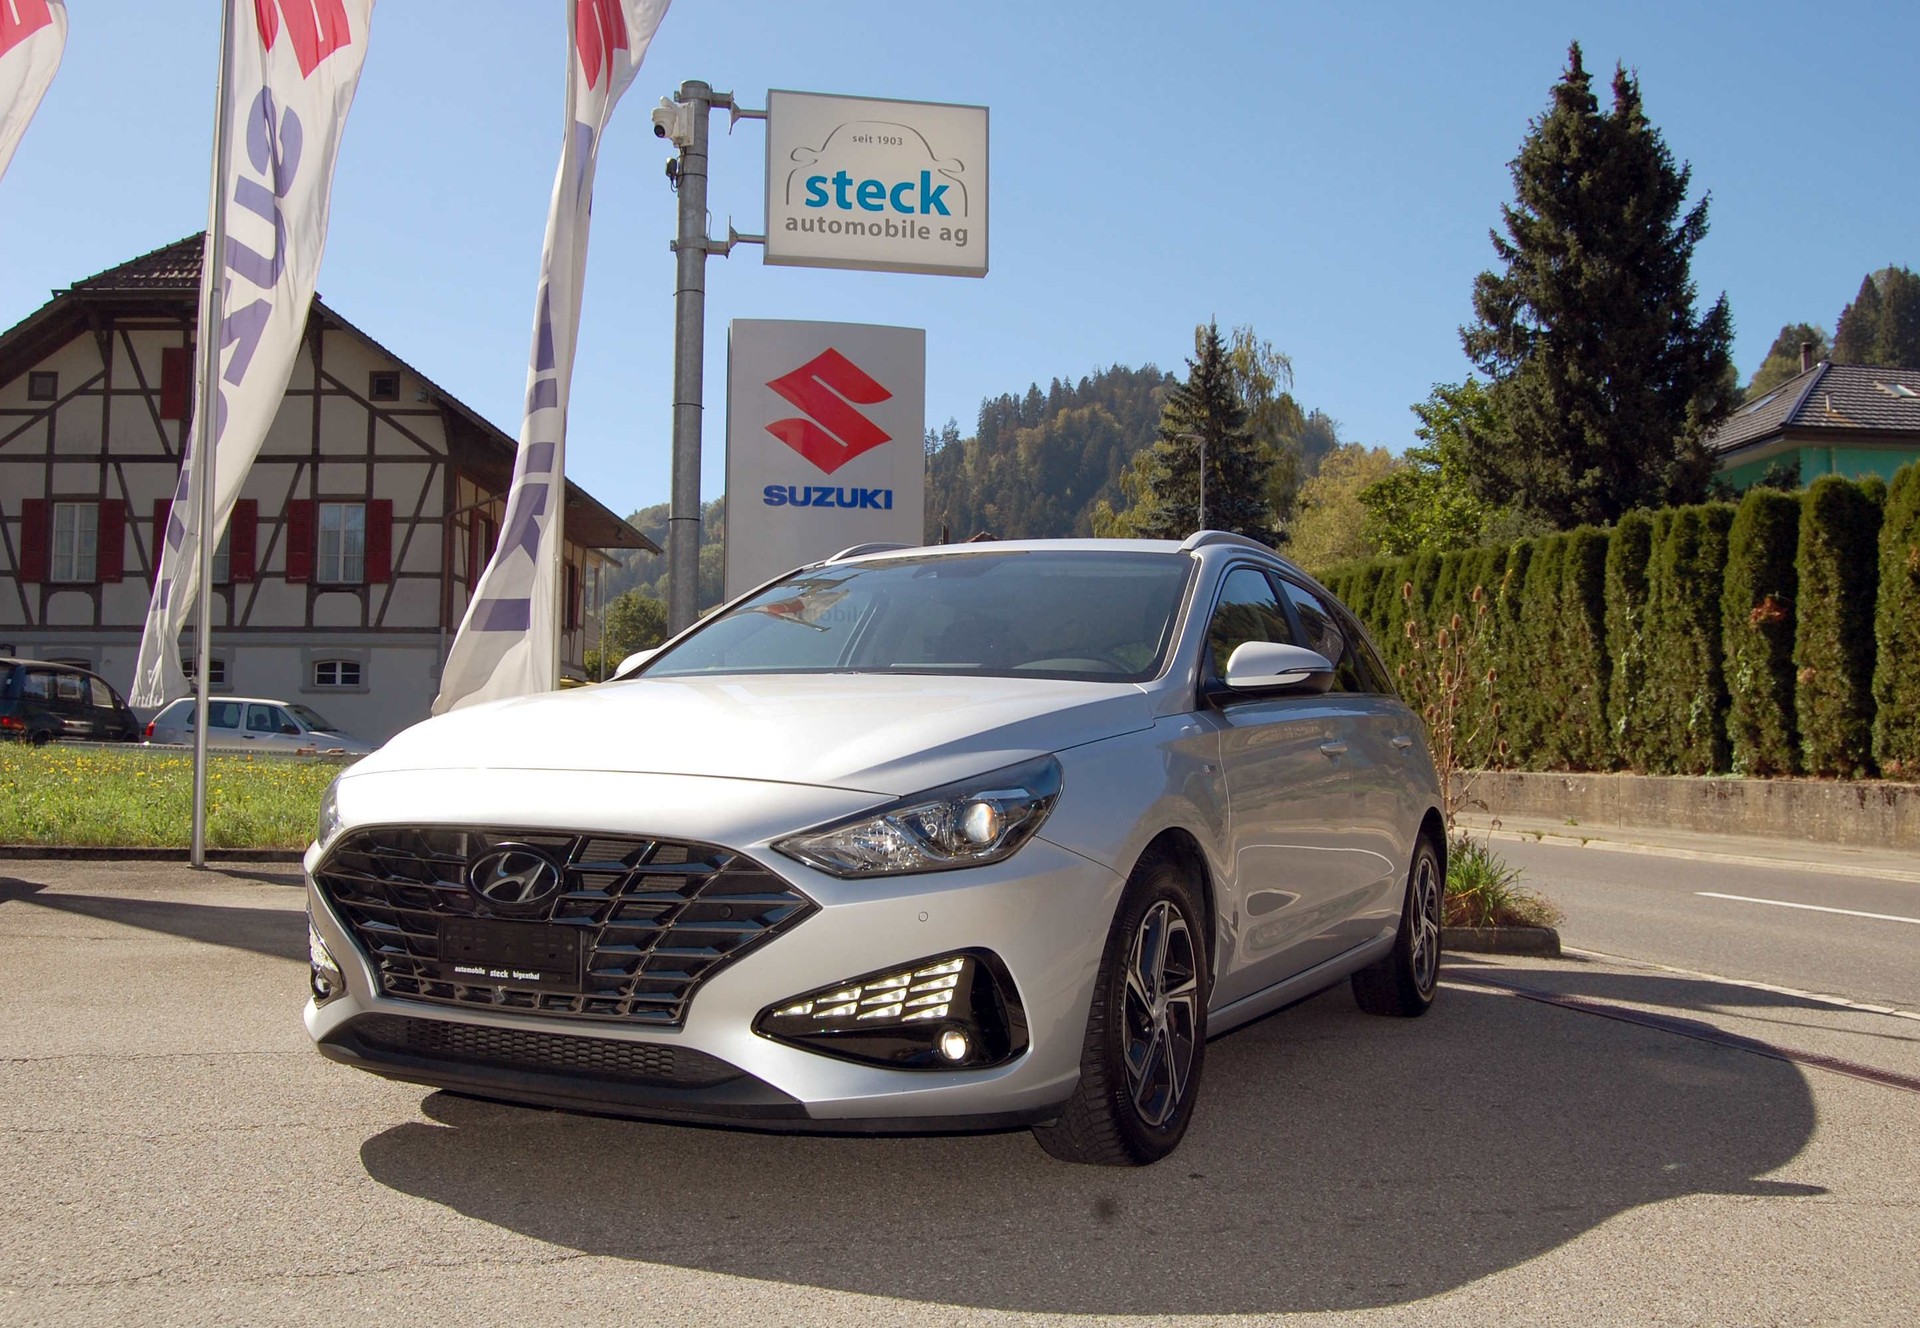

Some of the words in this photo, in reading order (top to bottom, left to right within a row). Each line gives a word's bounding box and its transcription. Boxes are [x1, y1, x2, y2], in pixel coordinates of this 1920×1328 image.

[852, 134, 873, 144] seit
[877, 135, 903, 146] 1903
[805, 170, 952, 216] steck
[785, 216, 931, 240] automobile
[939, 226, 968, 247] ag
[762, 485, 893, 510] SUZUKI
[489, 969, 509, 979] steck
